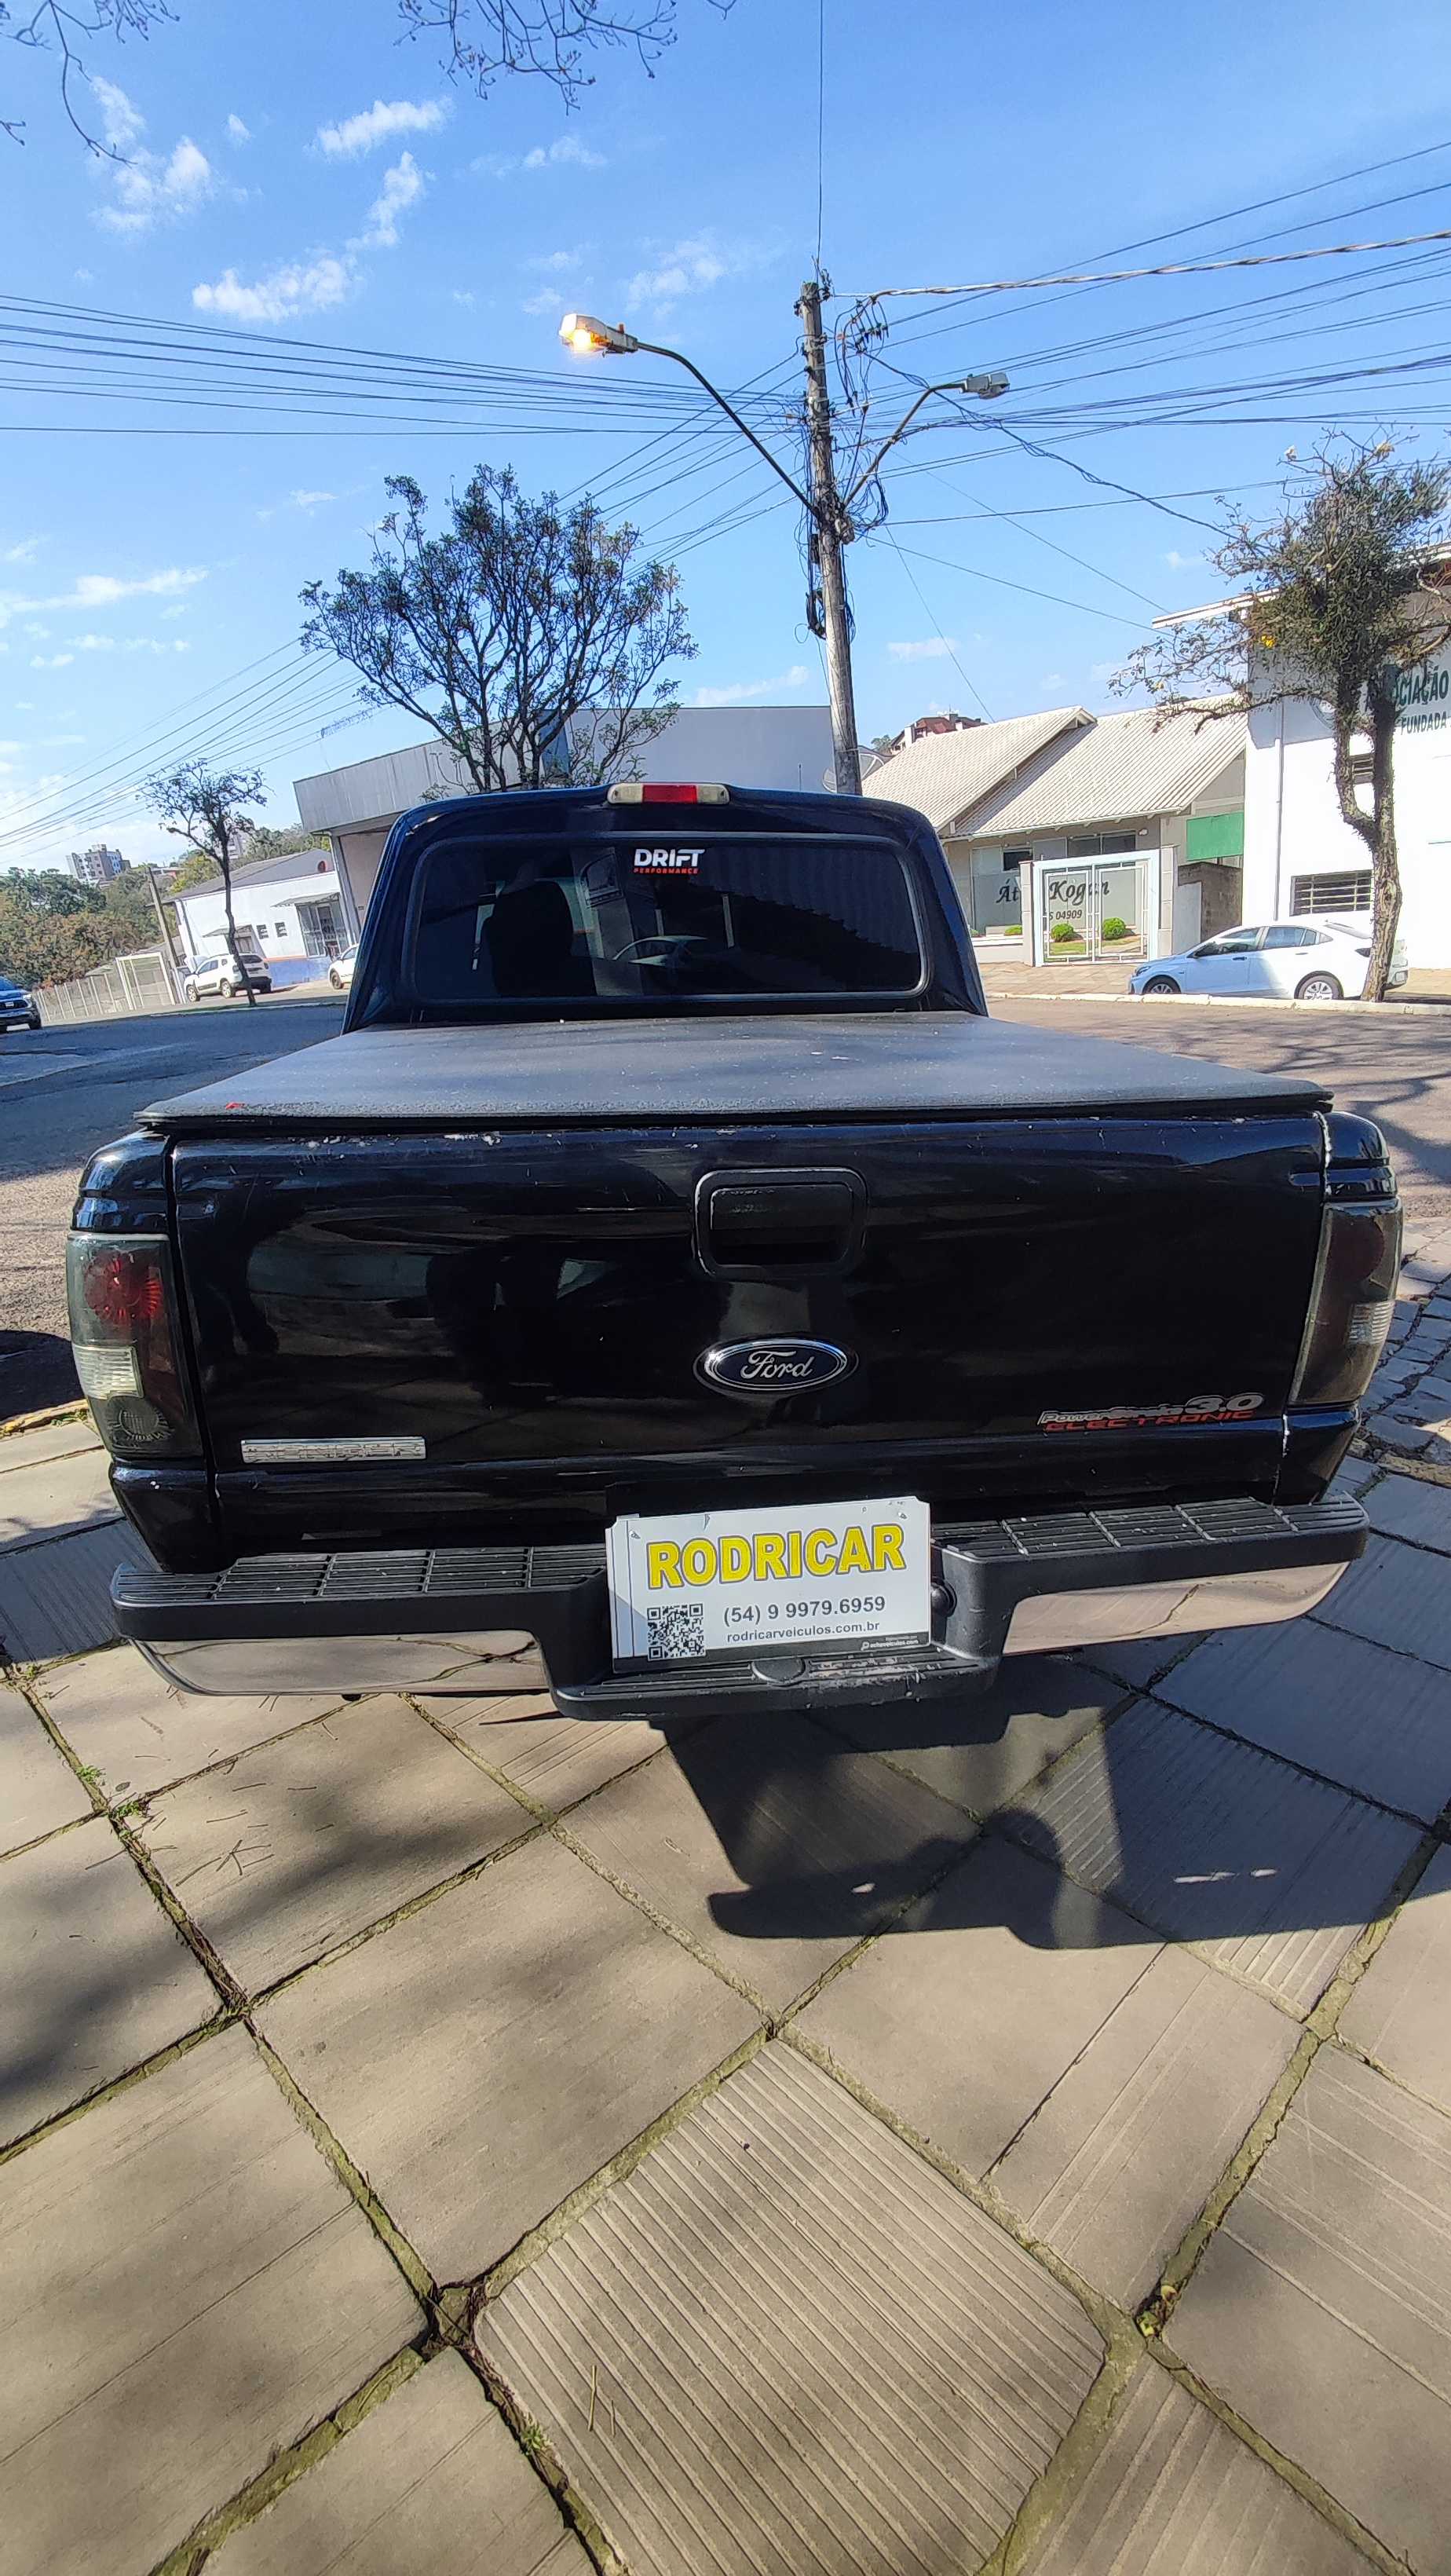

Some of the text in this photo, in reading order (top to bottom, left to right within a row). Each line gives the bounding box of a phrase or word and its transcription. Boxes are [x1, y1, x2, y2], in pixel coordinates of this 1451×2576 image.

[1401, 711, 1446, 735] FUNDADA
[634, 849, 705, 867] DRIFT
[1055, 909, 1082, 920] 04909
[740, 1350, 815, 1379] Ford
[1184, 1392, 1263, 1414] 3.0
[646, 1523, 906, 1590] RODRICAR
[724, 1596, 886, 1626] (54) 9 9979.6959
[727, 1621, 879, 1643] rodricarveiculos.com.br
